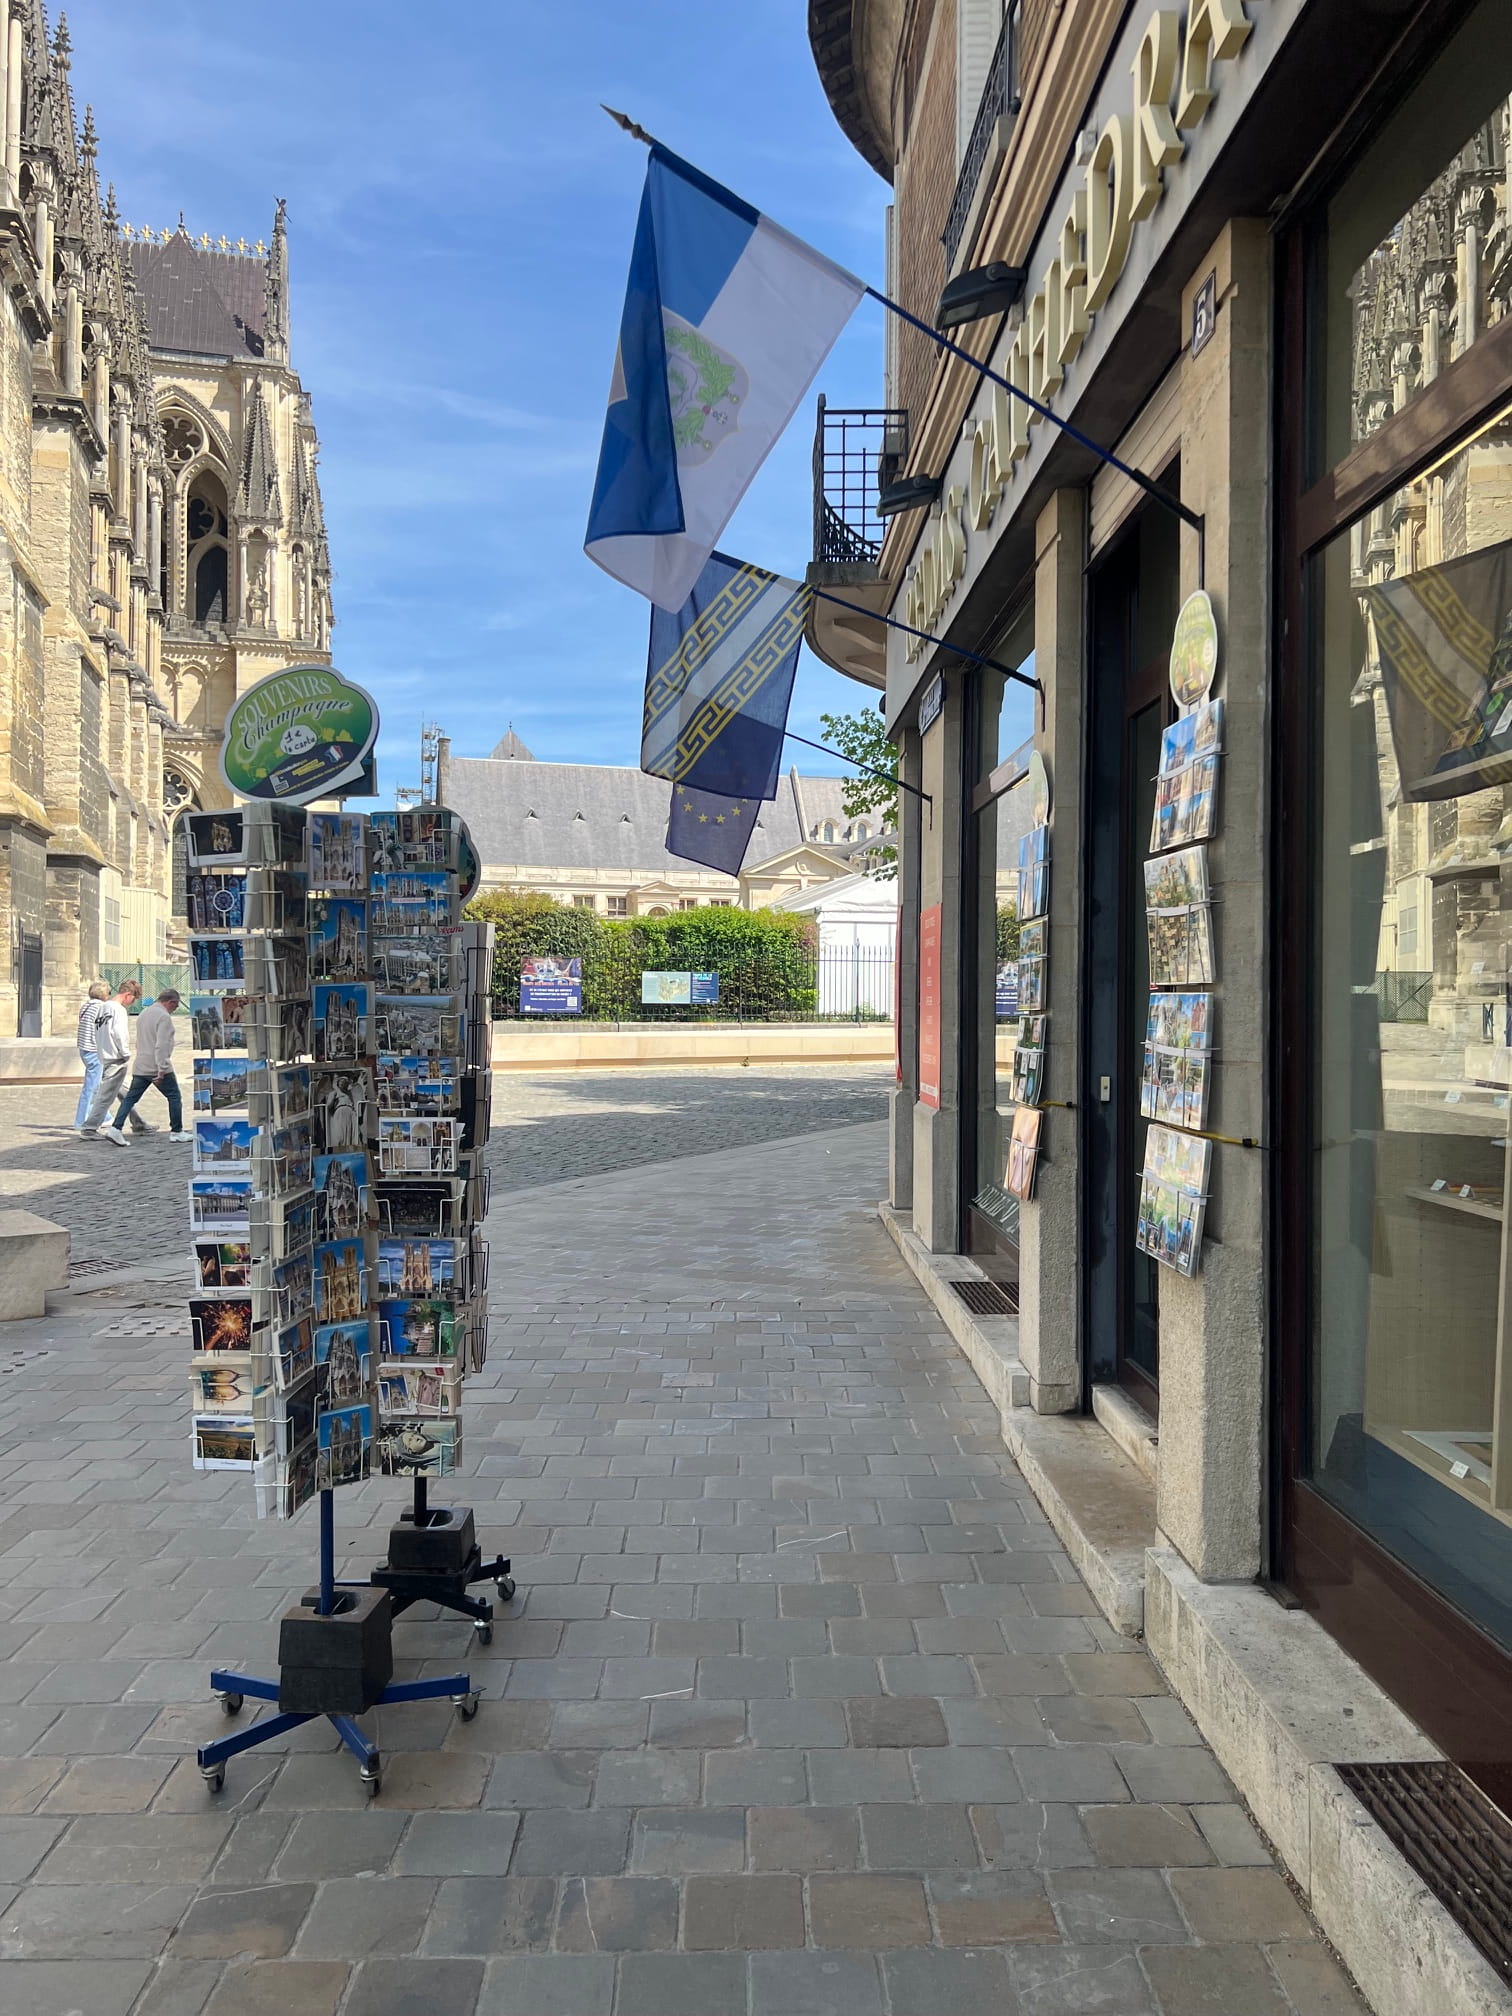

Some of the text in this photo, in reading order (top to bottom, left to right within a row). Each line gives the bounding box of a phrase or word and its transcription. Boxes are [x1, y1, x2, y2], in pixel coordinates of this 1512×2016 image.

[1195, 285, 1208, 341] 5
[904, 485, 967, 664] REIMS
[236, 699, 353, 760] Champagne
[237, 675, 332, 735] SOUVENIRS
